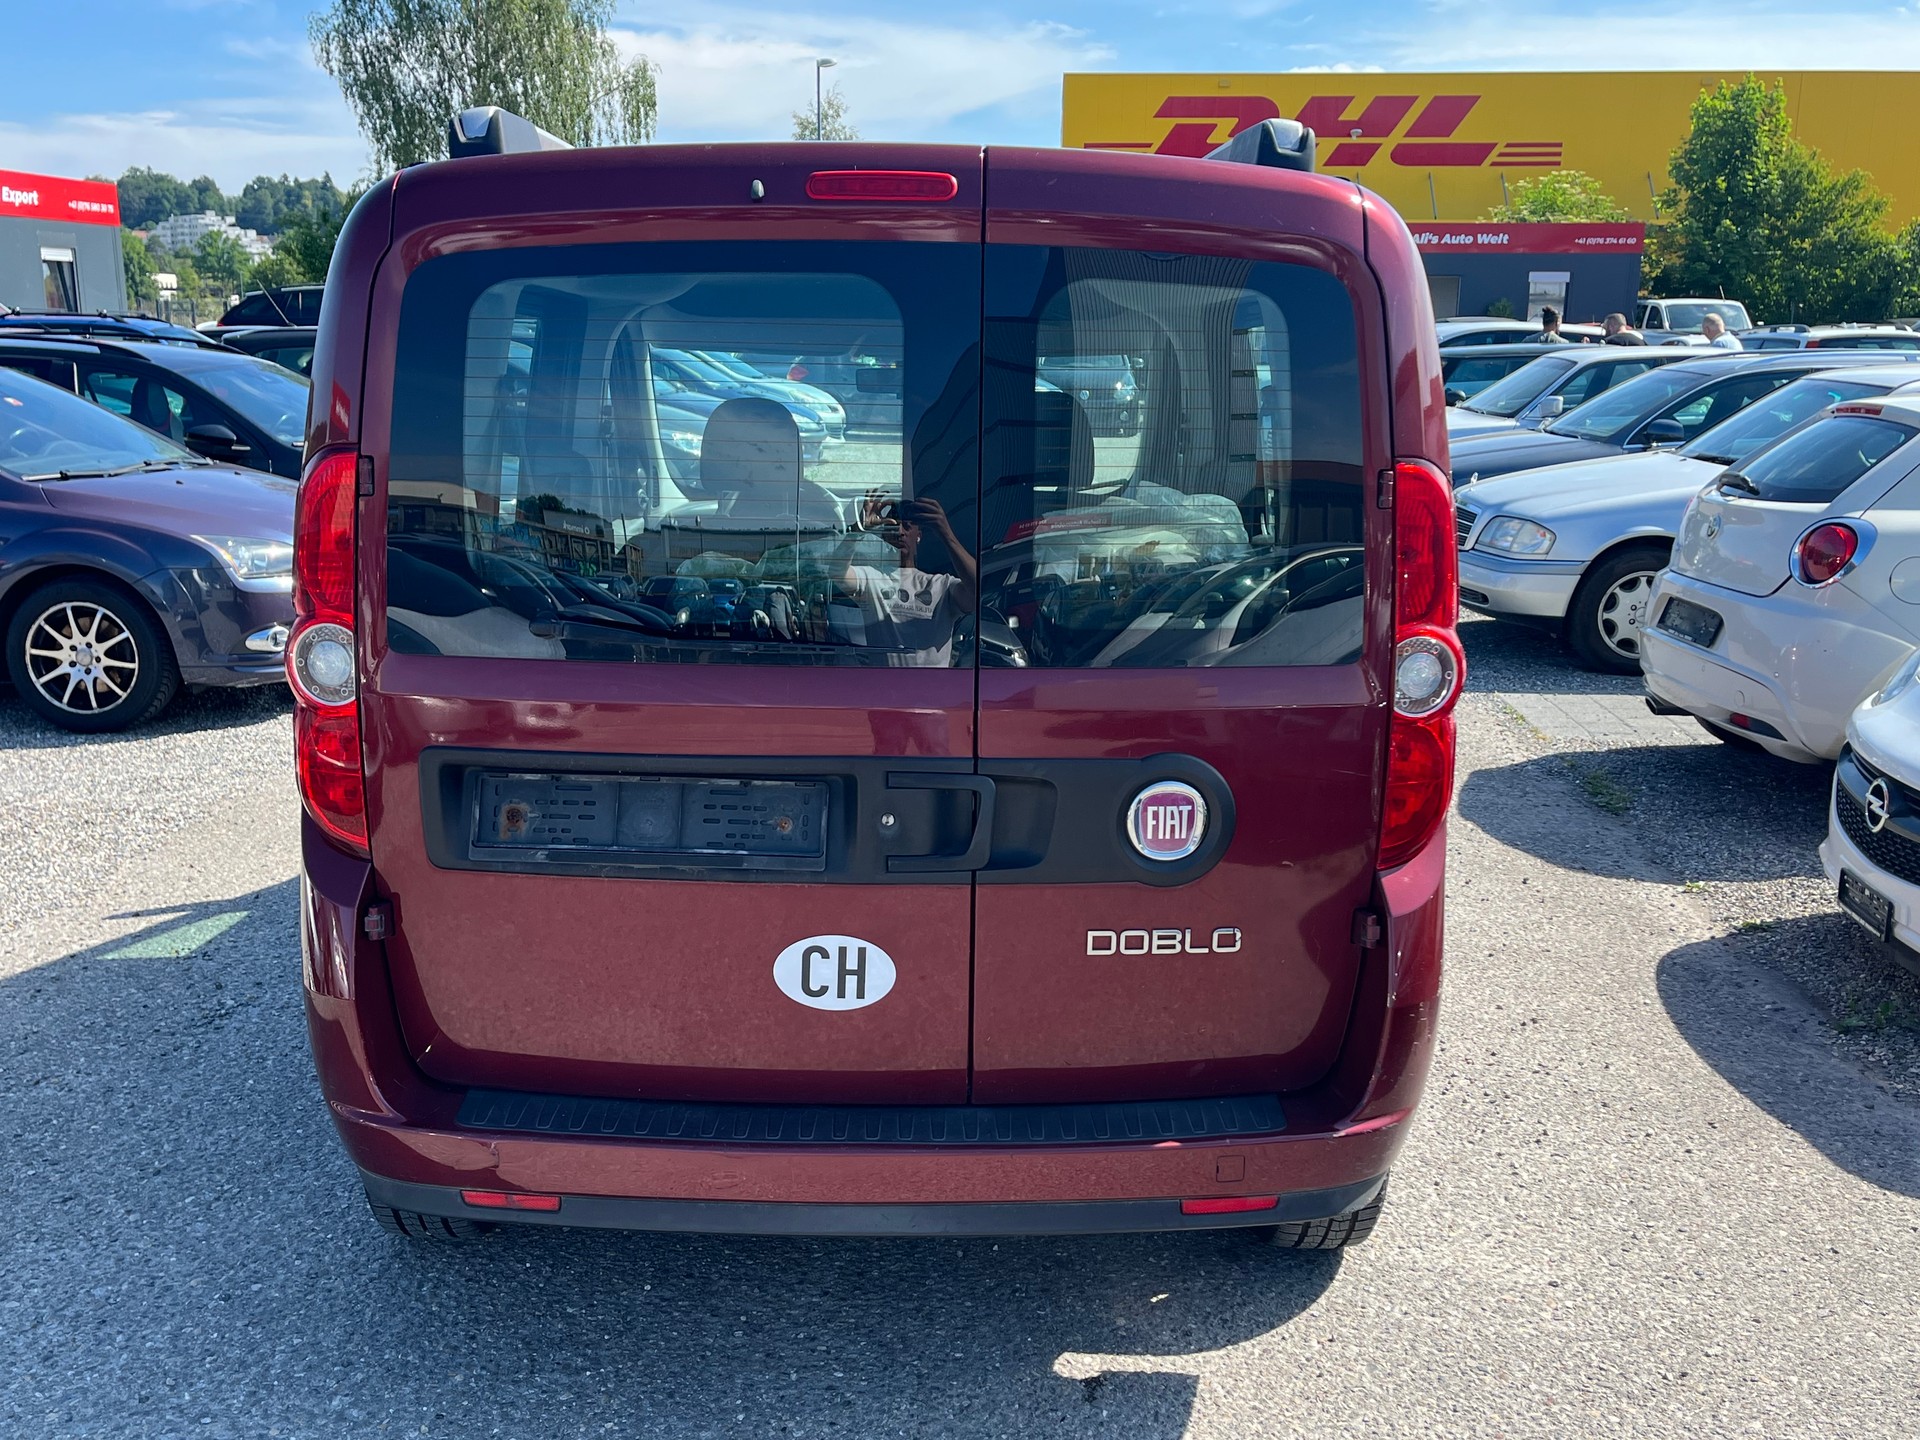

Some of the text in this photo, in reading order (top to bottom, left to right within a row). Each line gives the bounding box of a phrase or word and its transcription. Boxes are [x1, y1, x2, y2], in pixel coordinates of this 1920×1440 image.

[1153, 95, 1498, 167] DHL
[2, 186, 38, 206] Export
[1441, 233, 1474, 245] Auto
[1477, 233, 1509, 245] Welt
[1574, 237, 1586, 245] +41
[1146, 805, 1193, 840] FIAT
[801, 944, 867, 1000] CH
